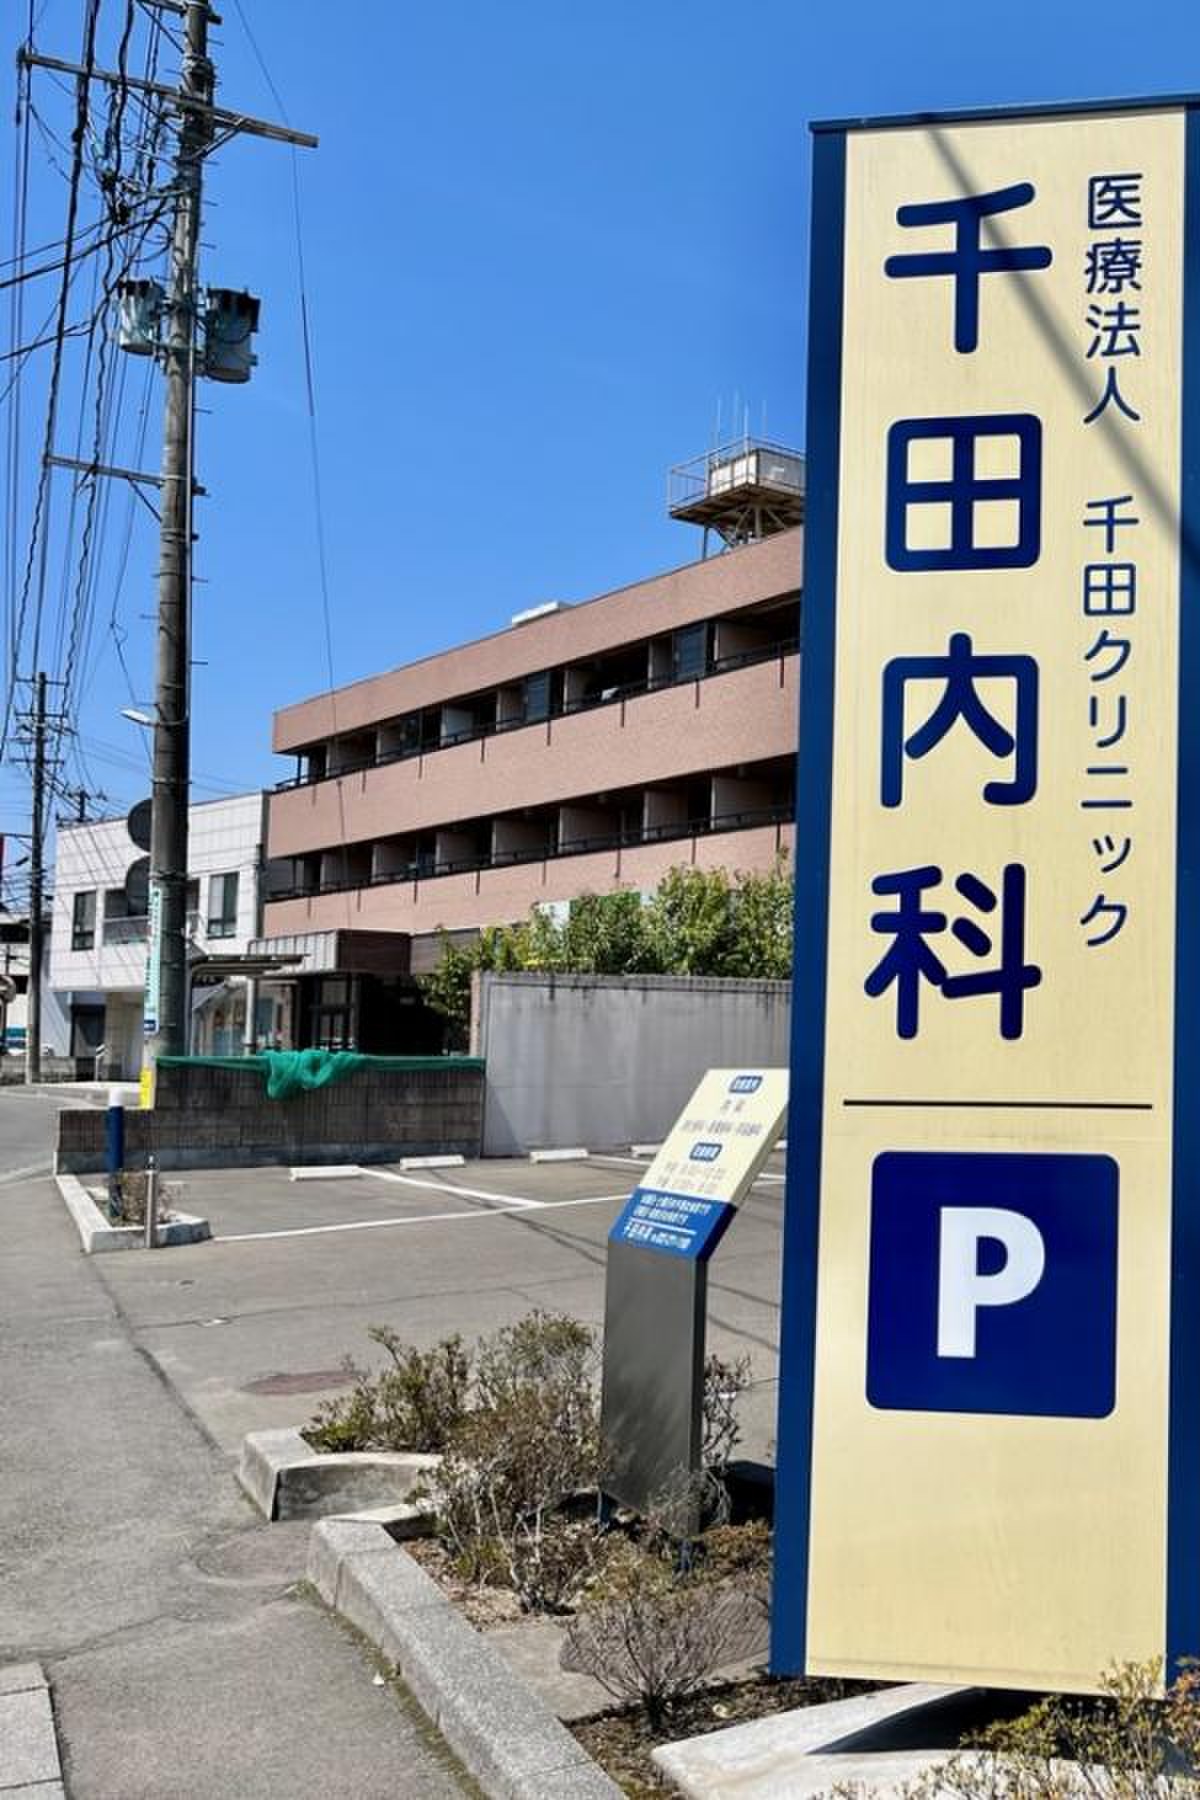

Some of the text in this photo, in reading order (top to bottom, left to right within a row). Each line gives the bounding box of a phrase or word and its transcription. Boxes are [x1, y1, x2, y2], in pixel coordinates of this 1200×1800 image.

[864, 182, 1053, 1040] 千田内科
[1080, 173, 1143, 946] 医療法人 千田クリニック
[937, 1206, 1045, 1358] P
